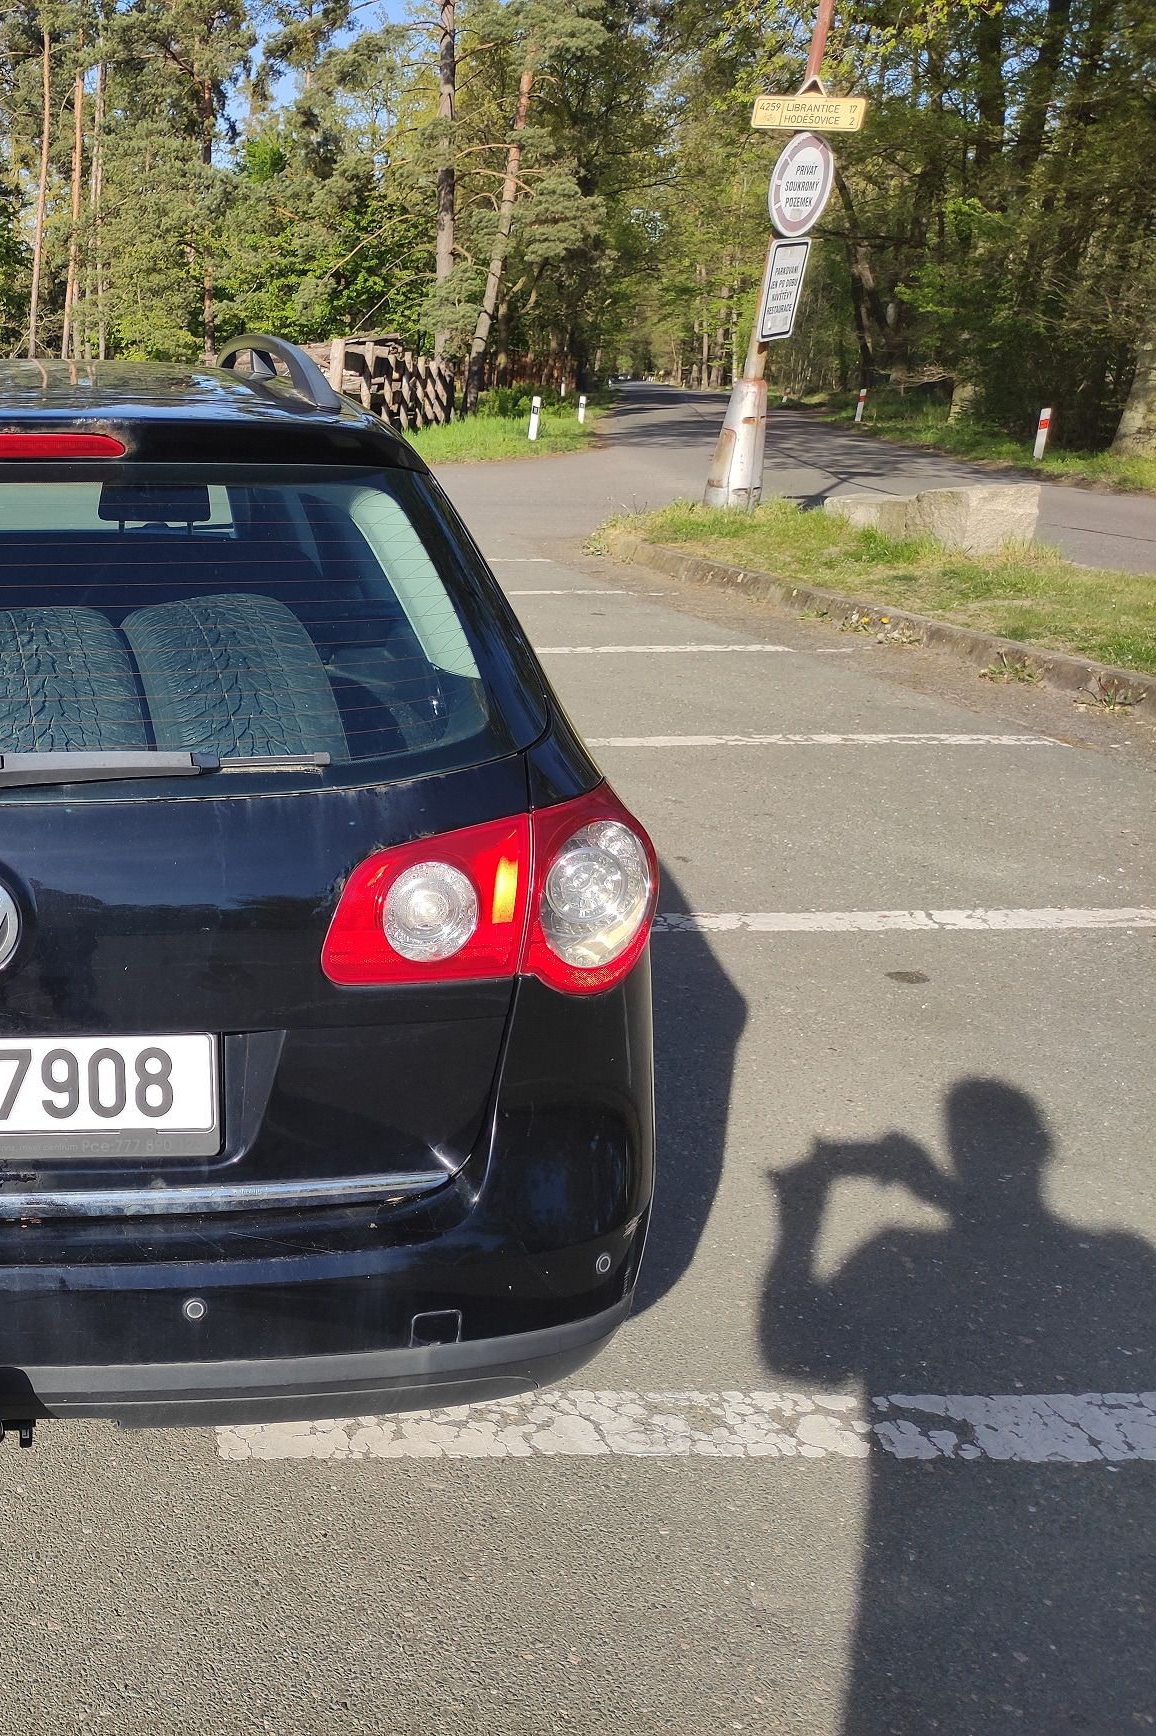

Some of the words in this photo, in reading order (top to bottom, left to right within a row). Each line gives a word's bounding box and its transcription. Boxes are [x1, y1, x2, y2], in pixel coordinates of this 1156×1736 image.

[760, 102, 781, 112] 4259
[786, 103, 841, 114] LIBRANTICE
[849, 105, 858, 113] 17
[784, 113, 840, 125] HODĚŠOVICE
[849, 118, 855, 126] 2
[795, 162, 818, 176] PRIVÁT
[784, 179, 820, 192] SOUKROMÝ
[784, 197, 813, 208] POZEMEK
